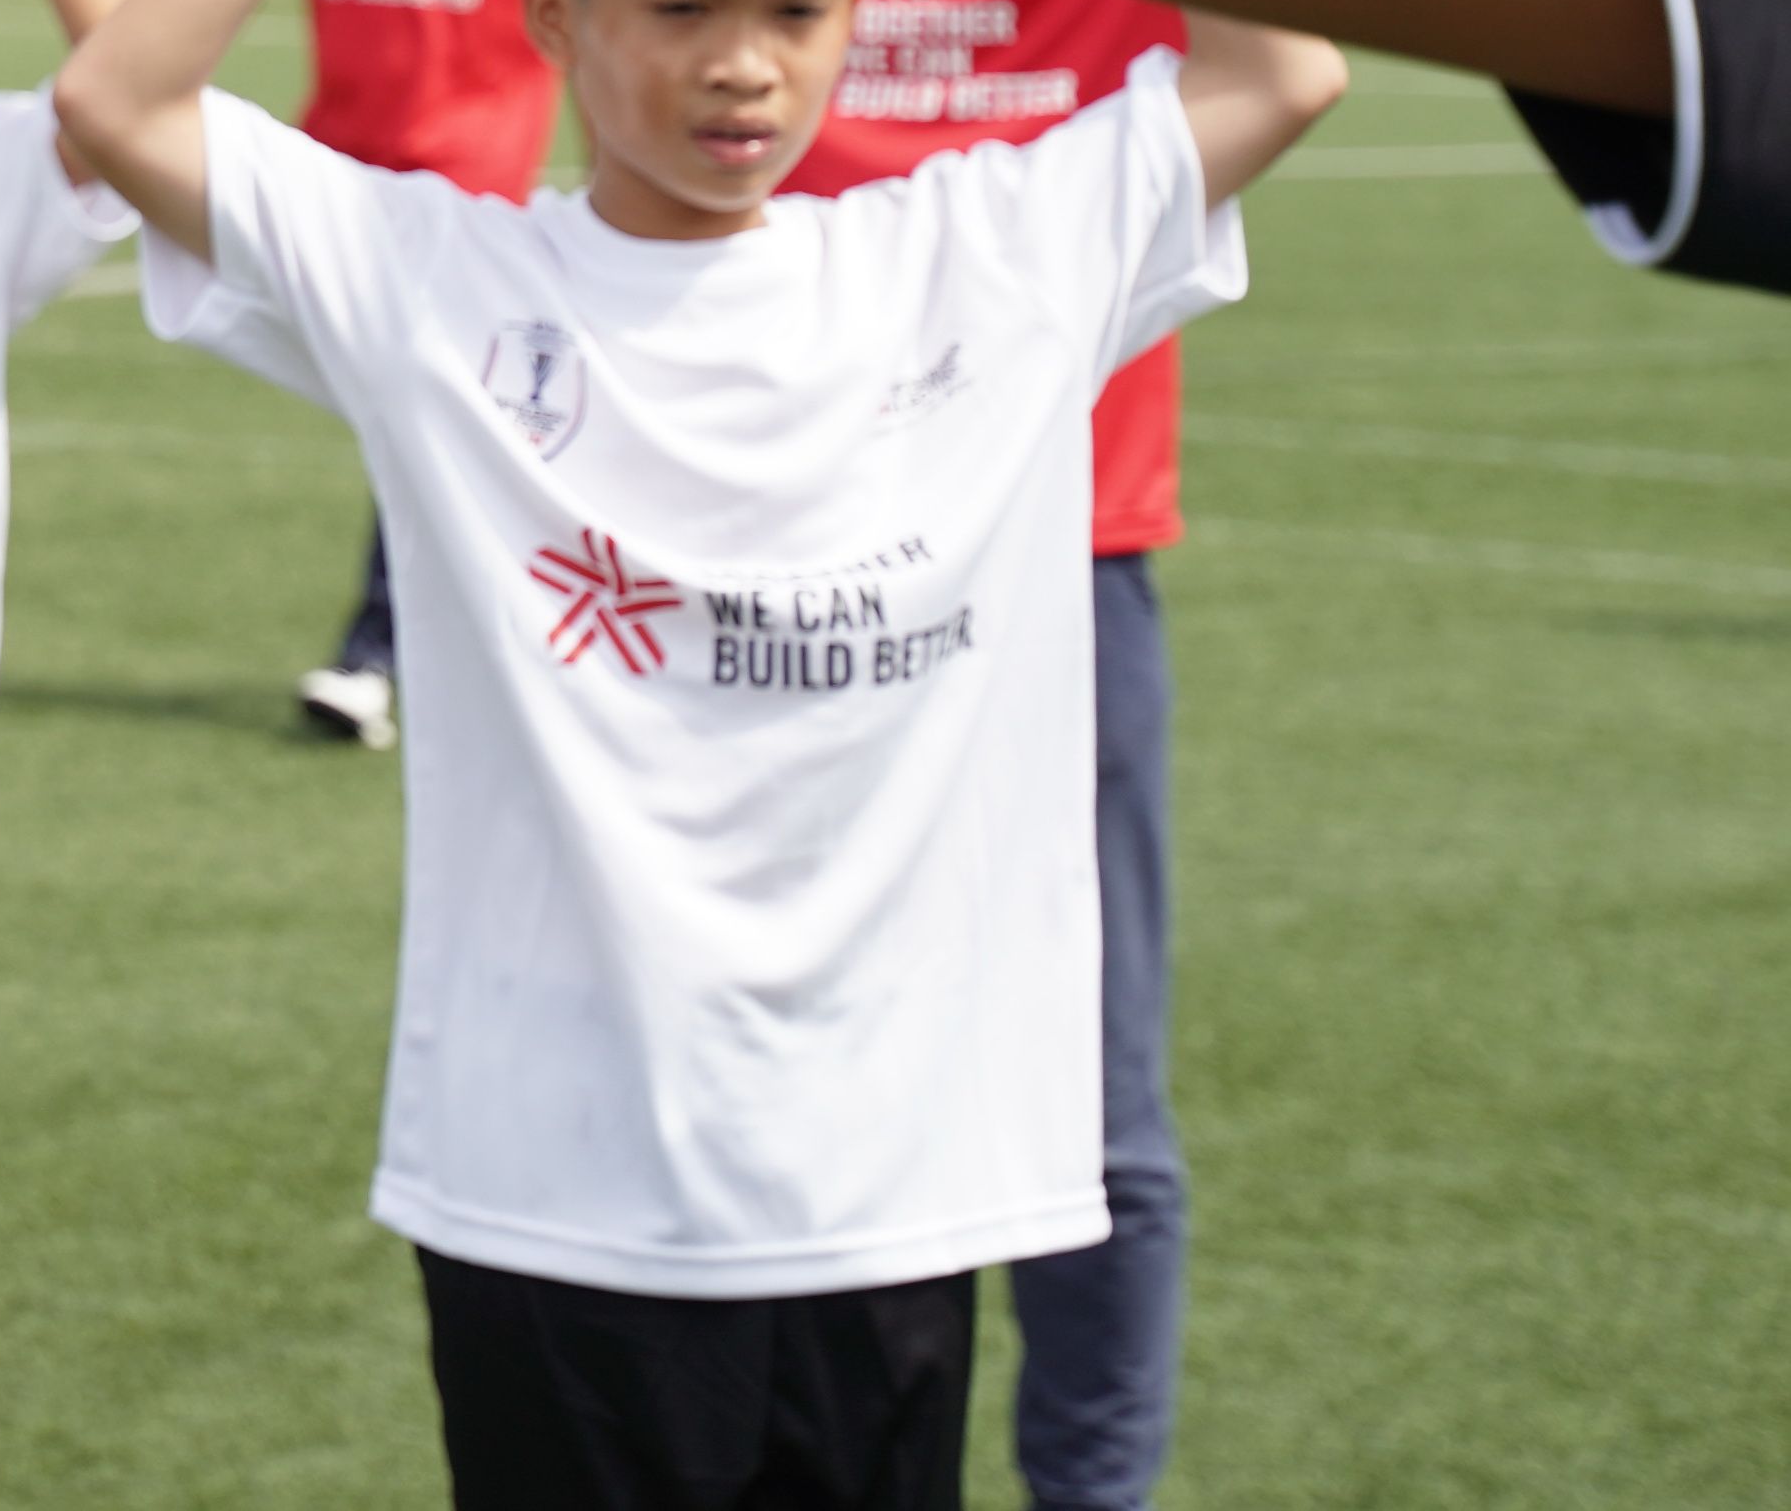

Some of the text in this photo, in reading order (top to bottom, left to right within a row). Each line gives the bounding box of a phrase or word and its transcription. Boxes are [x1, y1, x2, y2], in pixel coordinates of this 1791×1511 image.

[702, 583, 886, 633] WE CAN
[712, 636, 854, 690] BUILD
